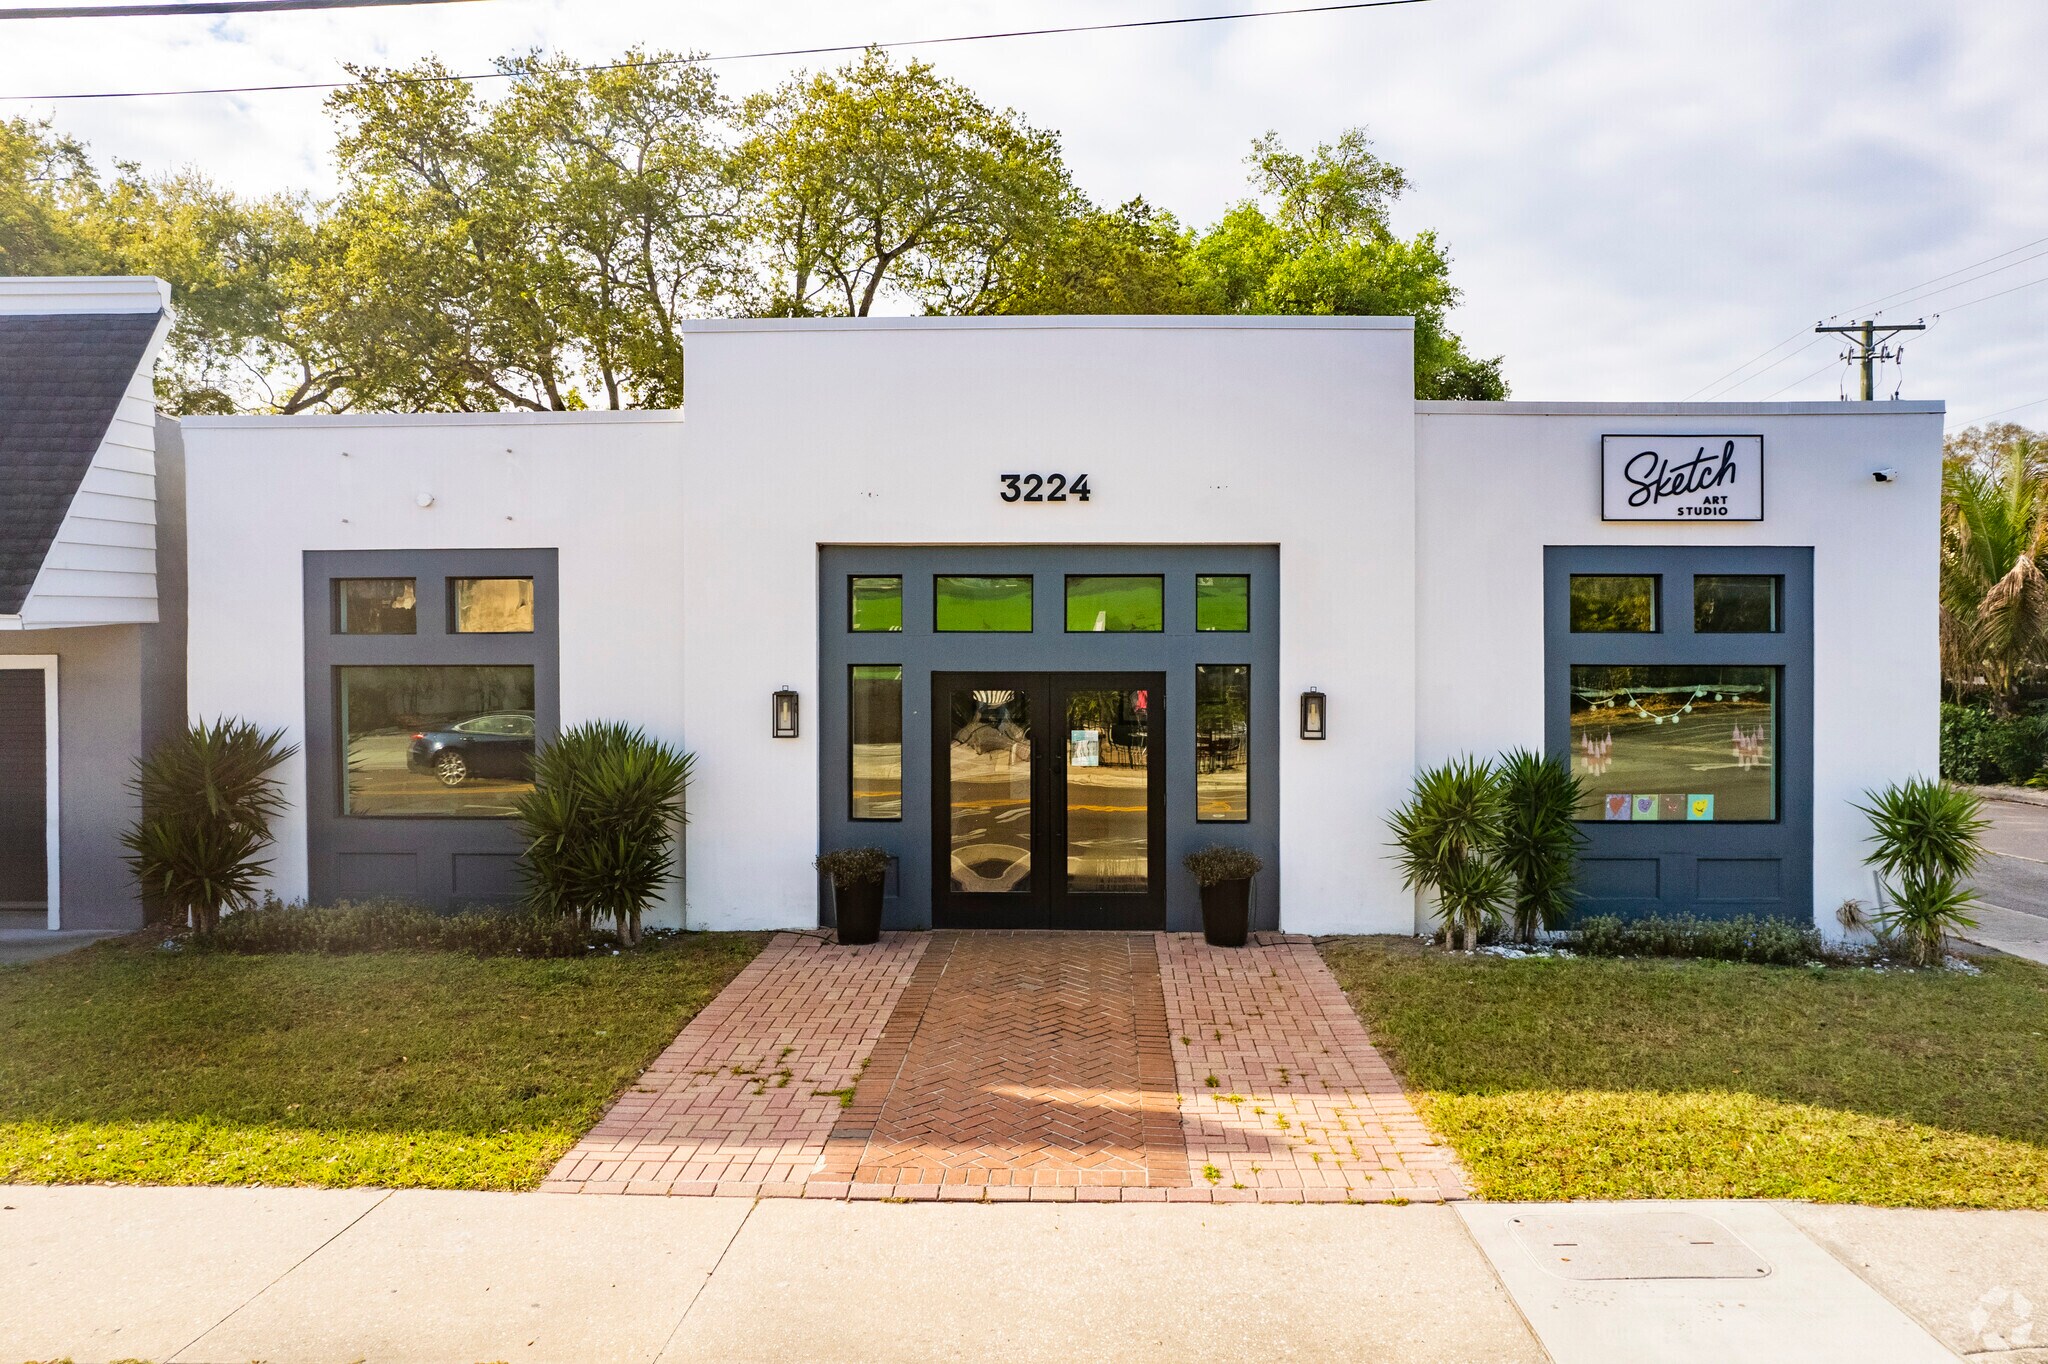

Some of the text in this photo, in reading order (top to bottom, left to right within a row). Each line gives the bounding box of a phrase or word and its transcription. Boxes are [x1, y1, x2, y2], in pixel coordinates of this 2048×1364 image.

[1624, 440, 1736, 507] Sketch
[1000, 473, 1091, 502] 3224
[1703, 496, 1728, 505] ART
[1677, 507, 1728, 516] STUDIO
